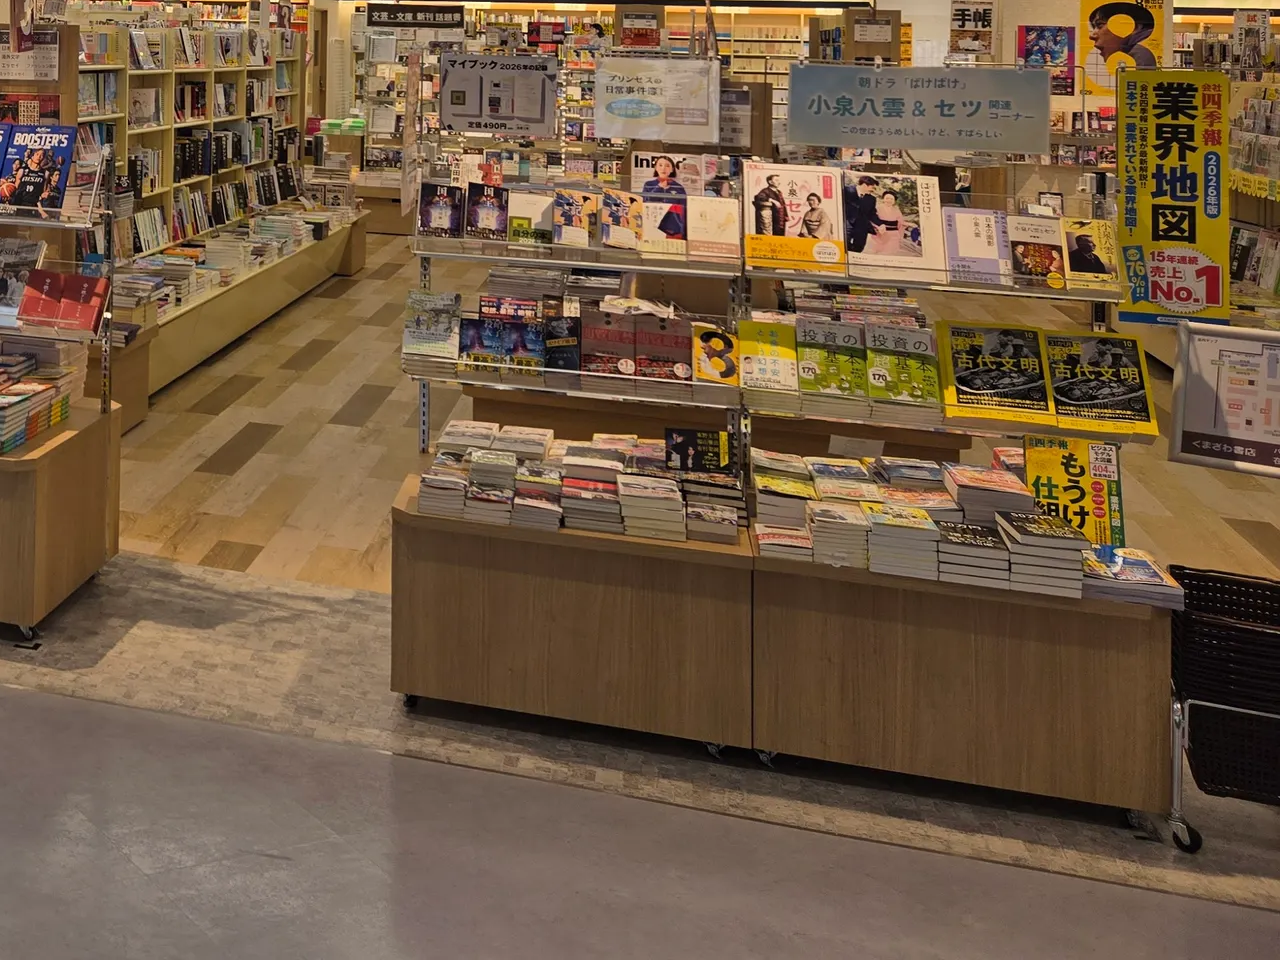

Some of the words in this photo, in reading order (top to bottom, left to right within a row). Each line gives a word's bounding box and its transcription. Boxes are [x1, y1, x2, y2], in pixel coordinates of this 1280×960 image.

[371, 11, 414, 22] 文芸・文庫
[416, 11, 434, 22] 新刊
[435, 12, 461, 23] 話題書
[952, 7, 993, 29] 手帳
[447, 58, 498, 71] マイブック
[500, 63, 548, 72] 2026年の記録
[608, 75, 662, 85] プリンセスの
[858, 76, 967, 90] 朝ドラ「ばけばけ」
[1201, 83, 1222, 91] 会社
[988, 100, 1012, 111] 関連
[988, 112, 1035, 121] コーナー
[1201, 91, 1223, 147] 四季報
[467, 121, 507, 130] 定価490円
[13, 132, 69, 147] BOOSTER'S
[1124, 80, 1137, 237] 日本で一番売れている業界地図!
[1151, 81, 1199, 244] 業界地図
[787, 180, 798, 198] 小泉
[1205, 154, 1218, 216] 2026年版
[785, 199, 802, 229] セツ
[1100, 222, 1114, 255] 小泉八雲
[1149, 250, 1200, 266] 15年連続
[1126, 260, 1145, 277] 76
[1149, 265, 1183, 279] 売上
[1149, 263, 1223, 306] No.1
[801, 329, 858, 345] 投資の
[871, 334, 929, 352] 投資の
[802, 366, 817, 375] 170
[955, 352, 1040, 374] 古代文明
[872, 373, 887, 382] 170
[1052, 363, 1140, 384] 古代文明
[1090, 445, 1114, 453] ビジネス
[1192, 440, 1257, 457] くまざわ書店
[1091, 464, 1109, 473] 404
[1060, 452, 1090, 530] もうけ
